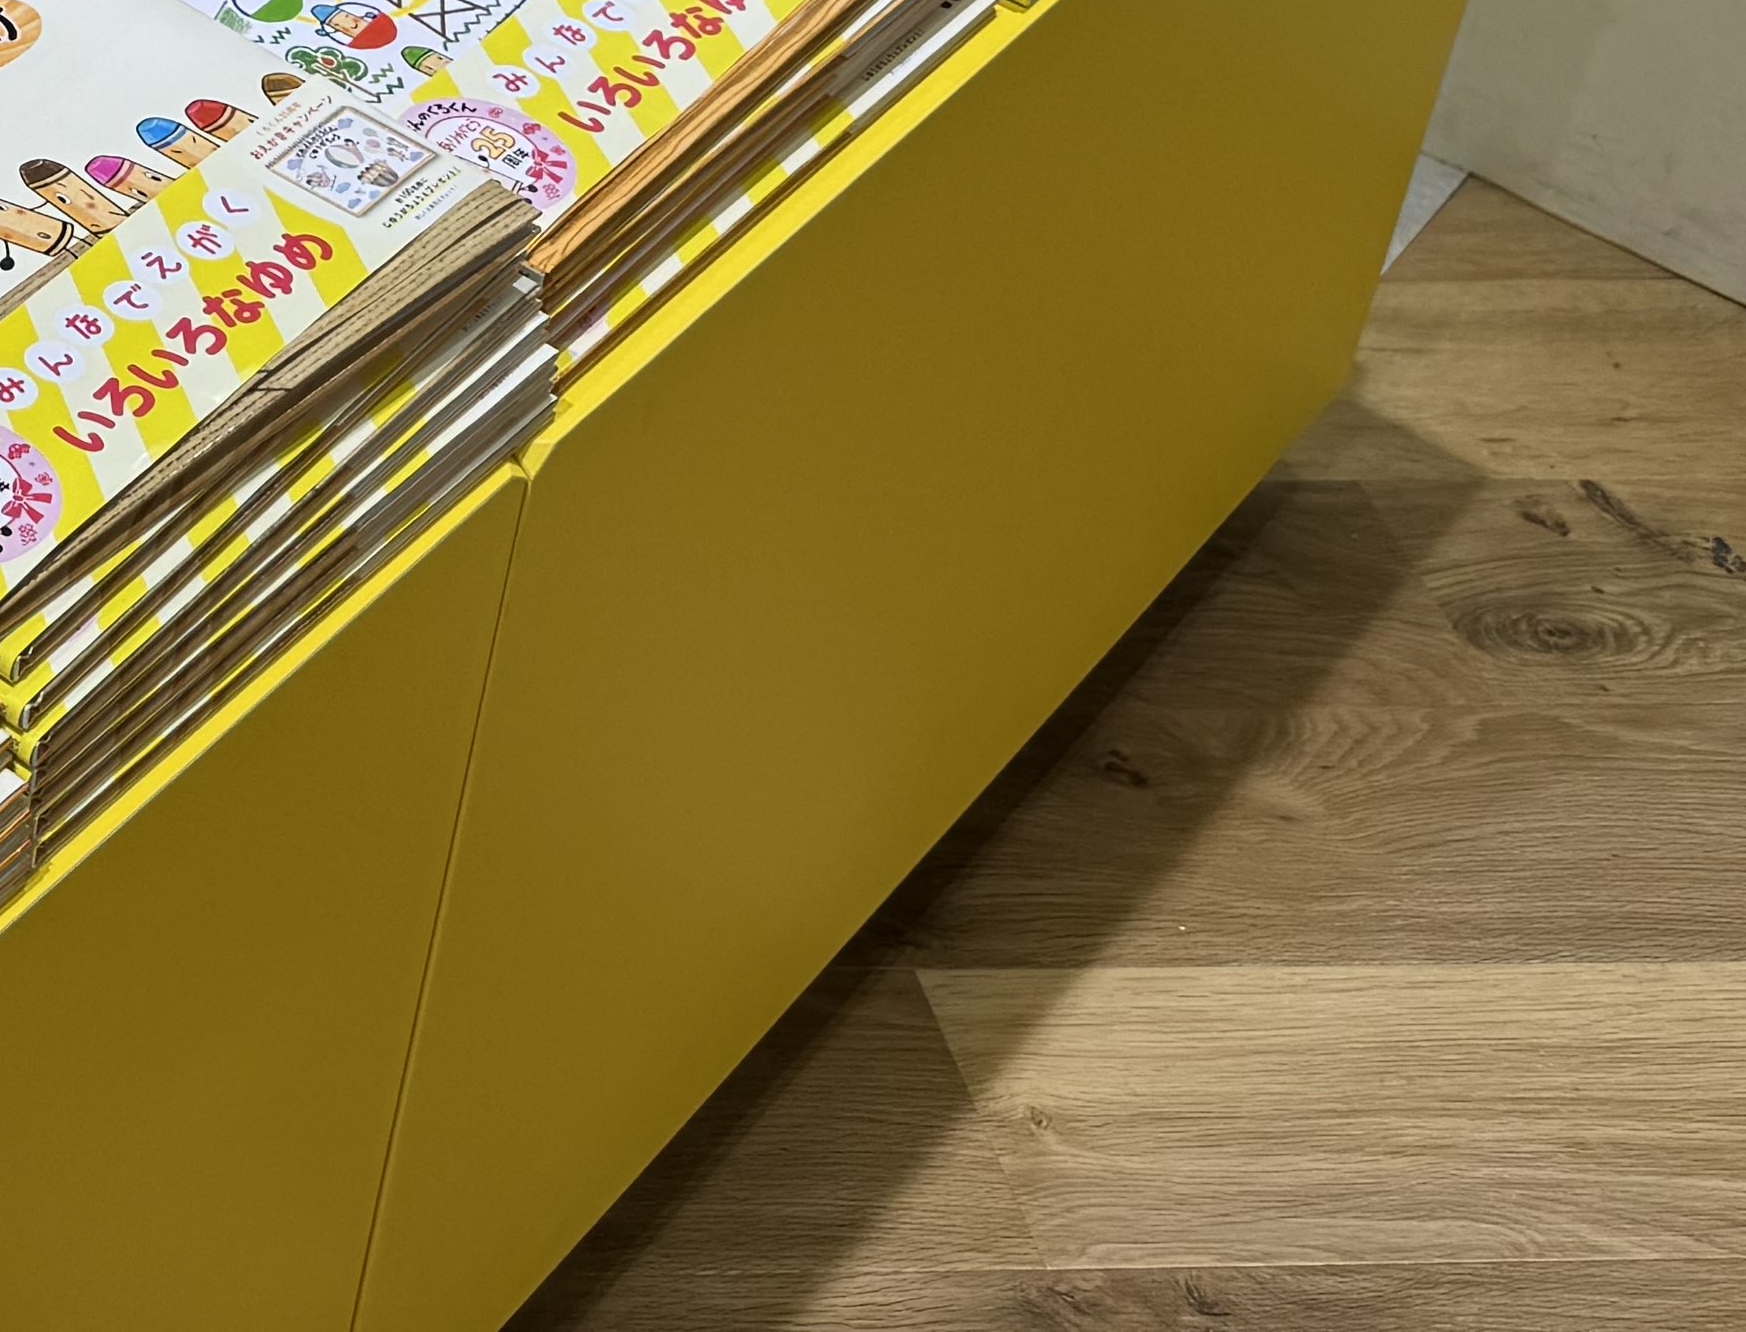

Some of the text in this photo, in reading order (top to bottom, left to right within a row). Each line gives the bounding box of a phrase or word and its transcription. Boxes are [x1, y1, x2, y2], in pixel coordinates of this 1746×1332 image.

[53, 231, 335, 456] いろいろなゆめ
